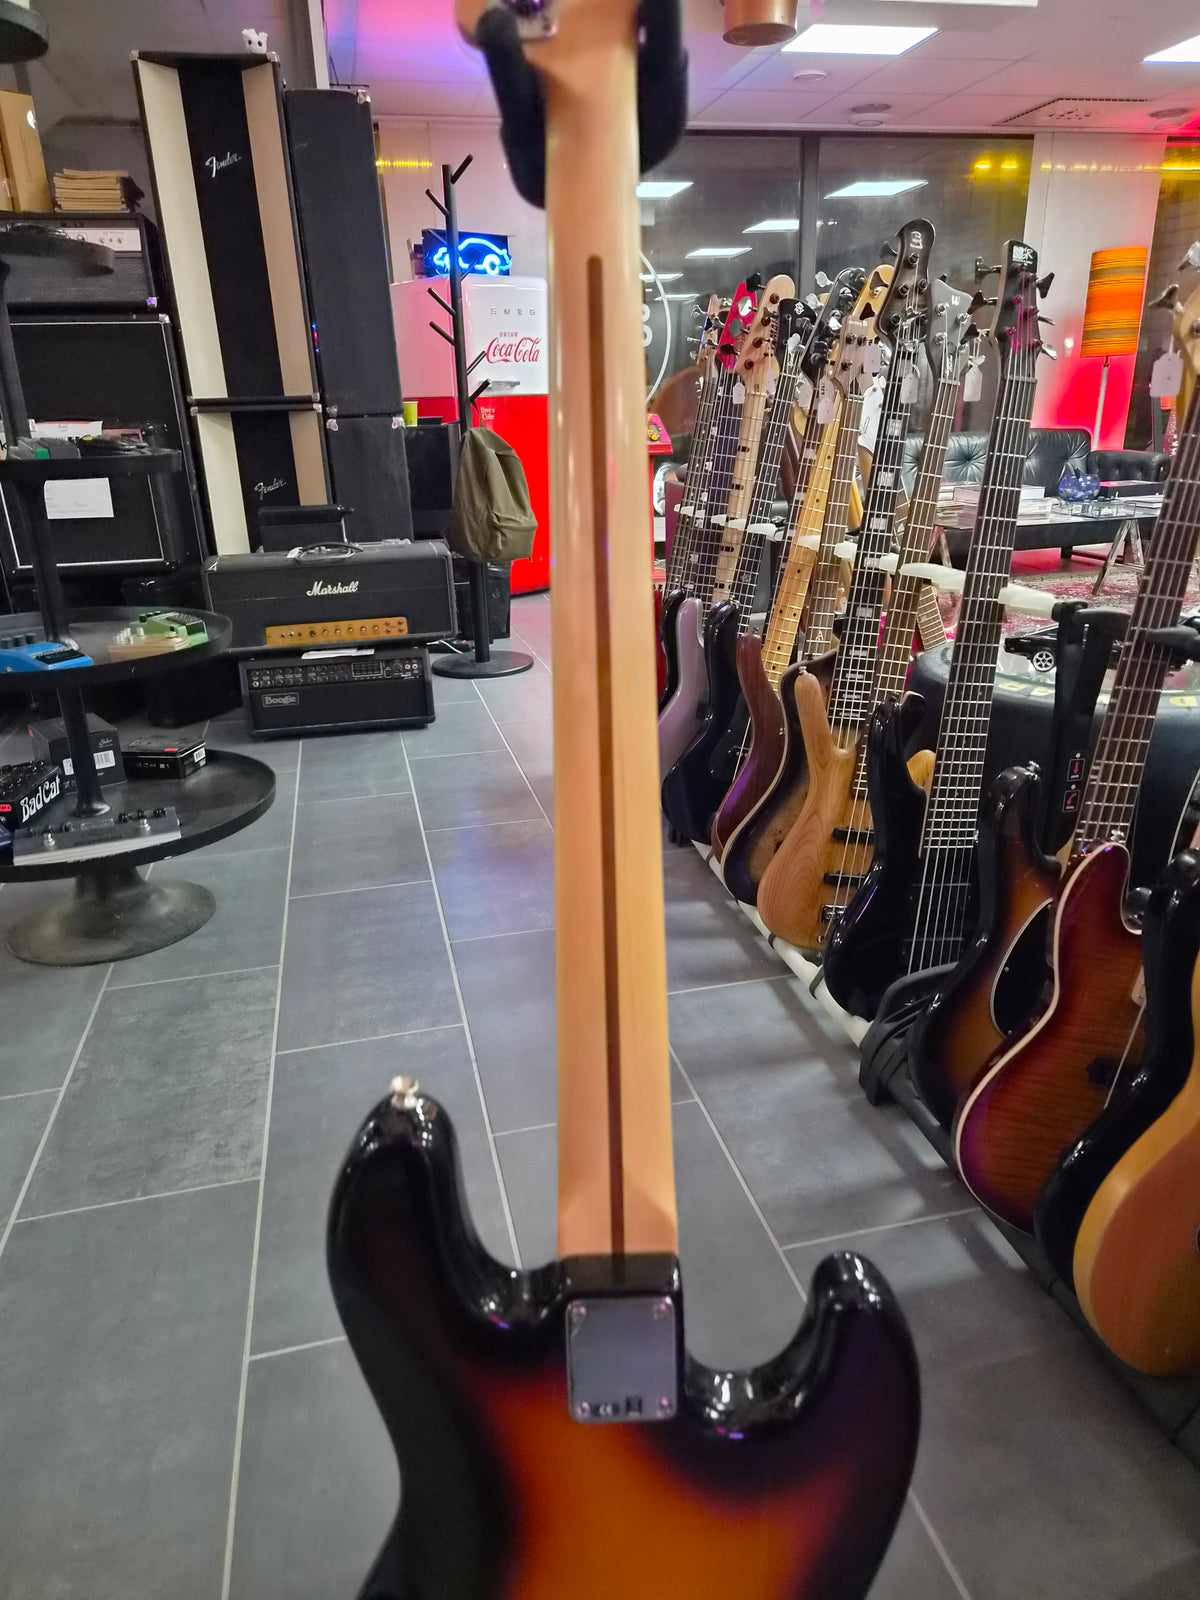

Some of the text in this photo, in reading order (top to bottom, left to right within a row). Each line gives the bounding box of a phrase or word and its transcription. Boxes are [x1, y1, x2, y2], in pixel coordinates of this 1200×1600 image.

[205, 151, 242, 178] Fender
[490, 307, 536, 316] SMEG
[253, 477, 287, 501] Fender
[306, 580, 359, 597] Marshall
[264, 695, 297, 705] Boogie
